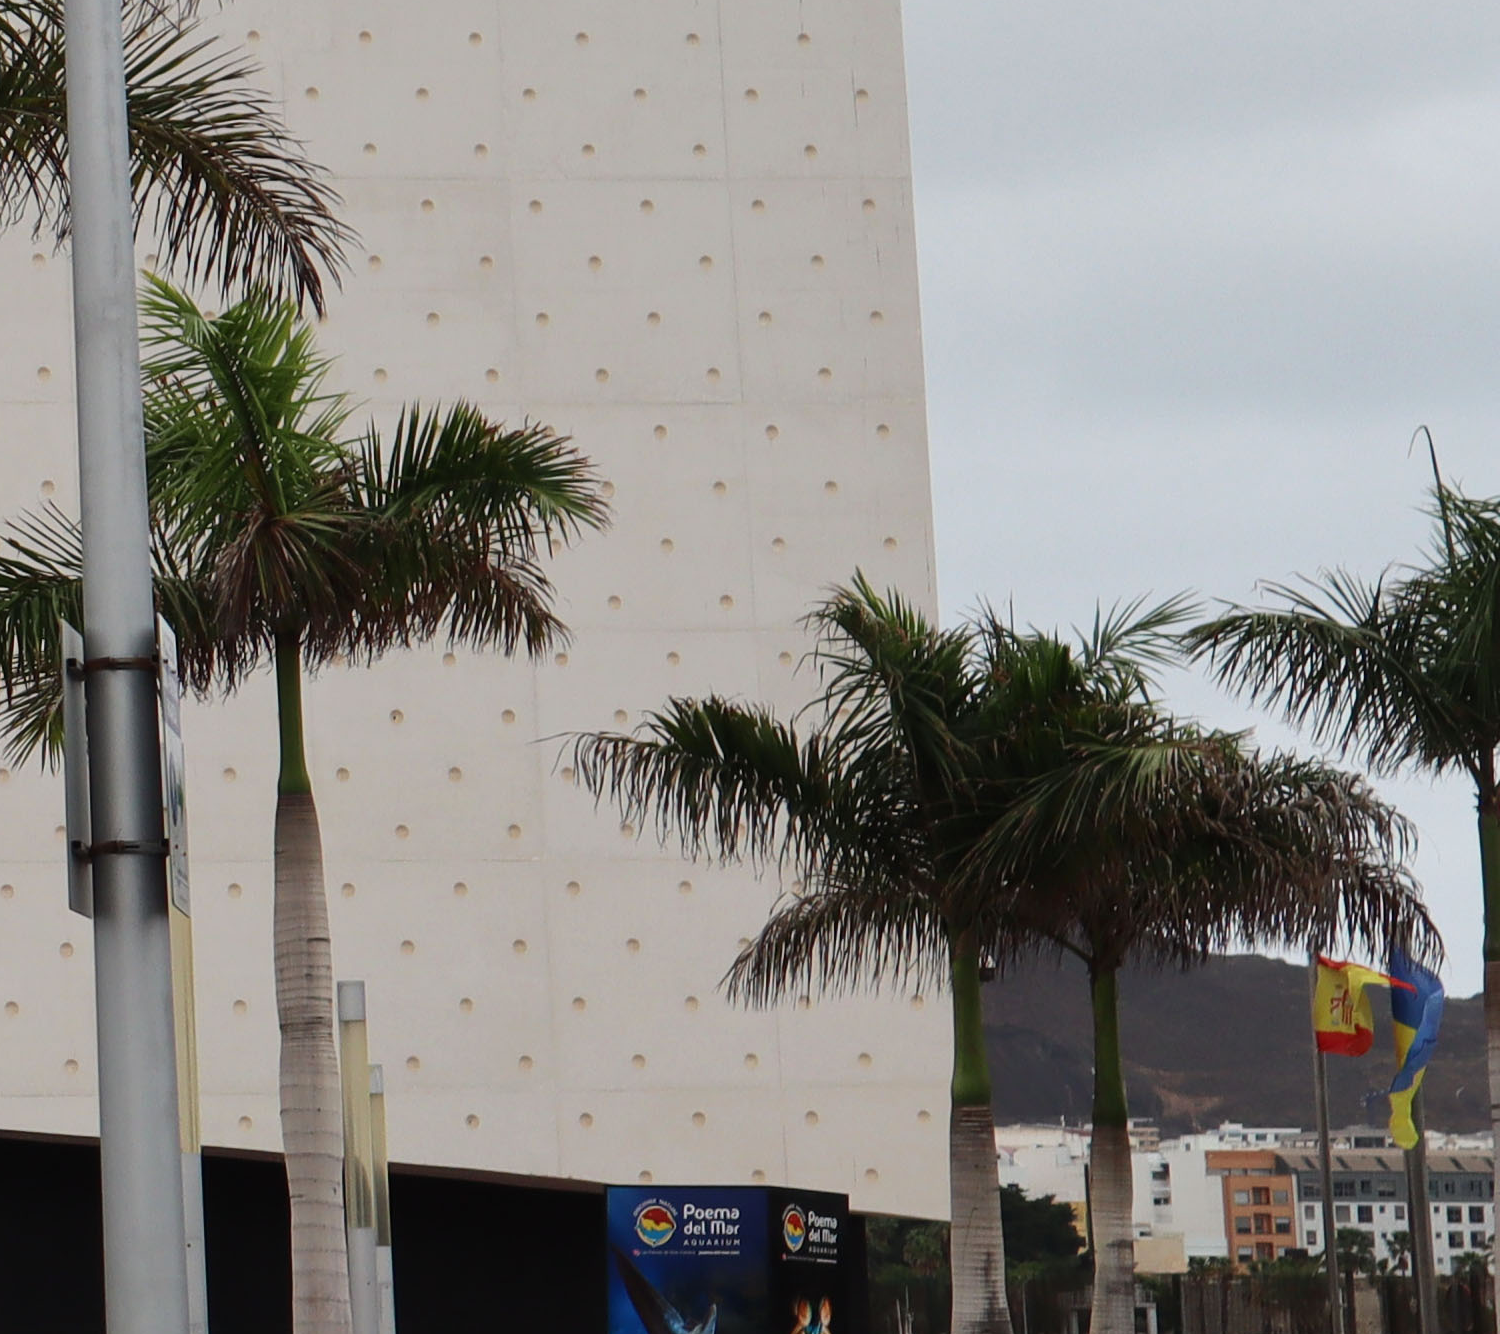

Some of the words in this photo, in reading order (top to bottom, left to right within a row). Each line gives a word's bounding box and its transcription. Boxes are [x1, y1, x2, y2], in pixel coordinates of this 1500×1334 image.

[683, 1203, 740, 1220] Poema
[808, 1210, 838, 1229] Poema
[683, 1220, 706, 1235] del
[710, 1219, 740, 1235] Mar
[683, 1238, 741, 1247] AQUARIUM
[808, 1228, 820, 1243] del
[821, 1228, 838, 1244] Mar
